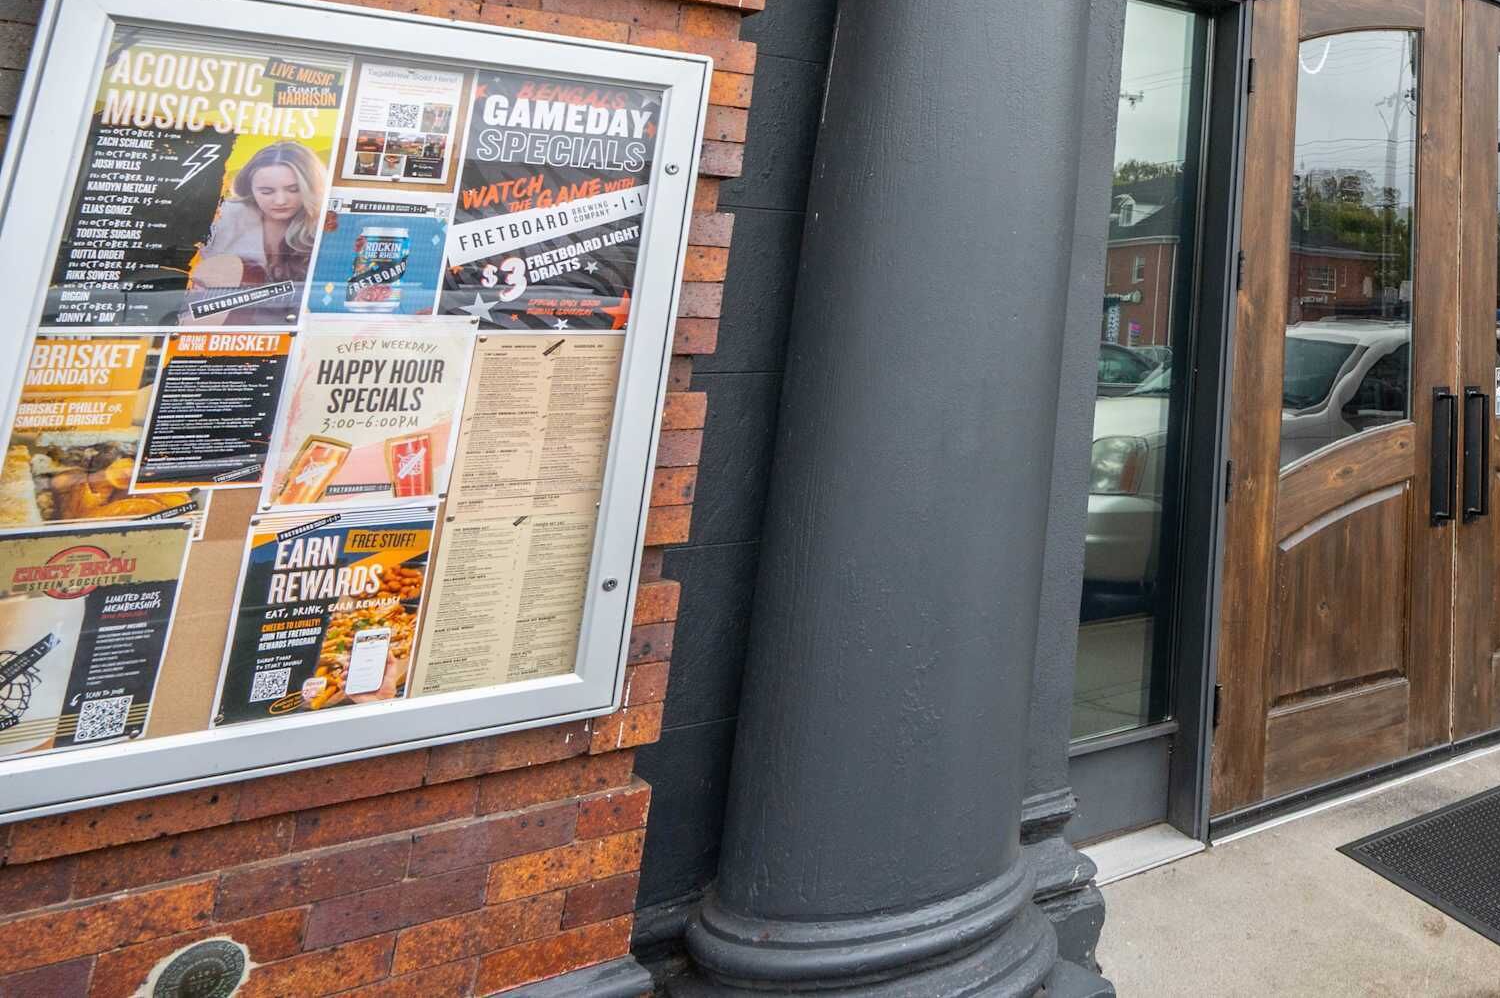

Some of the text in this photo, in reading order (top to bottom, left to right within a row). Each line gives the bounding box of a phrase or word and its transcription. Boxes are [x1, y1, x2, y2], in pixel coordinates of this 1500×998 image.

[111, 49, 266, 97] ACOUSTIC
[270, 61, 336, 86] LIVE MUSIC
[277, 91, 337, 107] HARRISON
[516, 82, 629, 110] BENGALS
[101, 89, 209, 132] MUSIC
[214, 98, 320, 139] SERIES
[483, 94, 653, 139] GAMEDAY
[476, 128, 647, 174] SPECIALS
[92, 158, 141, 171] JOSH WELLS
[463, 174, 544, 210] WATCH
[536, 178, 602, 209] GAME
[604, 176, 636, 194] WITH
[81, 204, 105, 214] ELIAS
[459, 210, 569, 251] FRETBOARD
[526, 236, 602, 270] FRETBOARD
[604, 226, 640, 247] LIGHT
[349, 259, 407, 296] FRETBOARD
[529, 257, 582, 283] DRAFTS
[197, 294, 250, 314] FRETBOARD
[208, 334, 281, 352] BRISKET!
[336, 339, 378, 354] EVERY
[30, 344, 141, 370] BRISKET
[26, 369, 111, 386] MONDAYS
[317, 359, 445, 385] HAPPY HOUR
[17, 402, 67, 415] BRISKET
[69, 401, 107, 414] PHILLY
[327, 387, 424, 414] SPECIALS
[15, 413, 112, 427] SMOKED BRISKET
[274, 532, 417, 570] EARN FREE STUFF!
[29, 576, 118, 592] STEIN SOCIETY
[267, 563, 384, 604] REWARDS
[105, 593, 140, 604] LIMITED
[265, 607, 289, 620] EAT,
[292, 605, 324, 618] DRINK,
[327, 600, 354, 612] EARN
[261, 621, 286, 633] CHEERS
